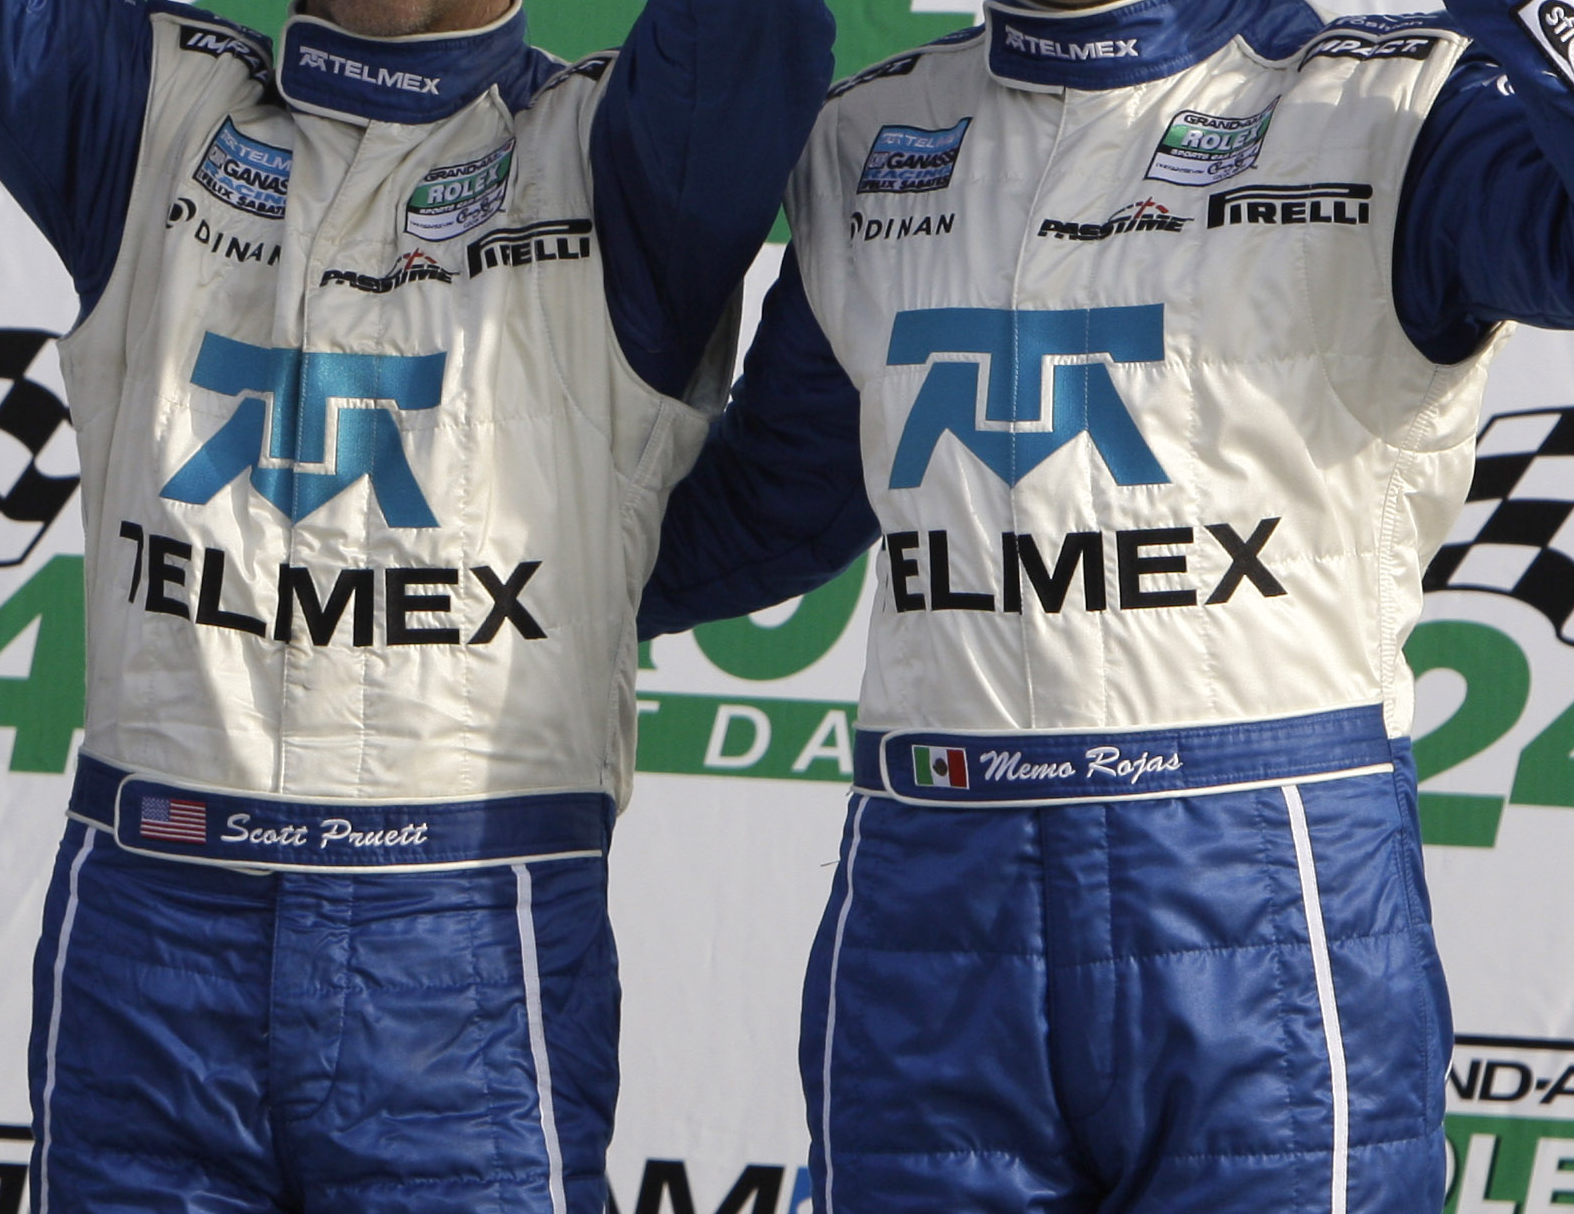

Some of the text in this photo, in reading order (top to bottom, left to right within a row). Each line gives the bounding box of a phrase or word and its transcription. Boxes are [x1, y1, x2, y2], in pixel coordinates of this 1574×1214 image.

[1023, 37, 1138, 60] TELMEX
[328, 59, 440, 95] TELMEX
[1181, 123, 1263, 151] ROLEX
[200, 170, 235, 200] FELIX
[427, 163, 502, 205] ROLEX
[1206, 182, 1374, 230] PIRELLI
[864, 212, 956, 242] DINAN
[467, 218, 593, 280] PIRELLI
[882, 515, 1289, 614] ELMEX
[978, 745, 1184, 785] Memo Rojas
[220, 812, 429, 850] Scott Pruett
